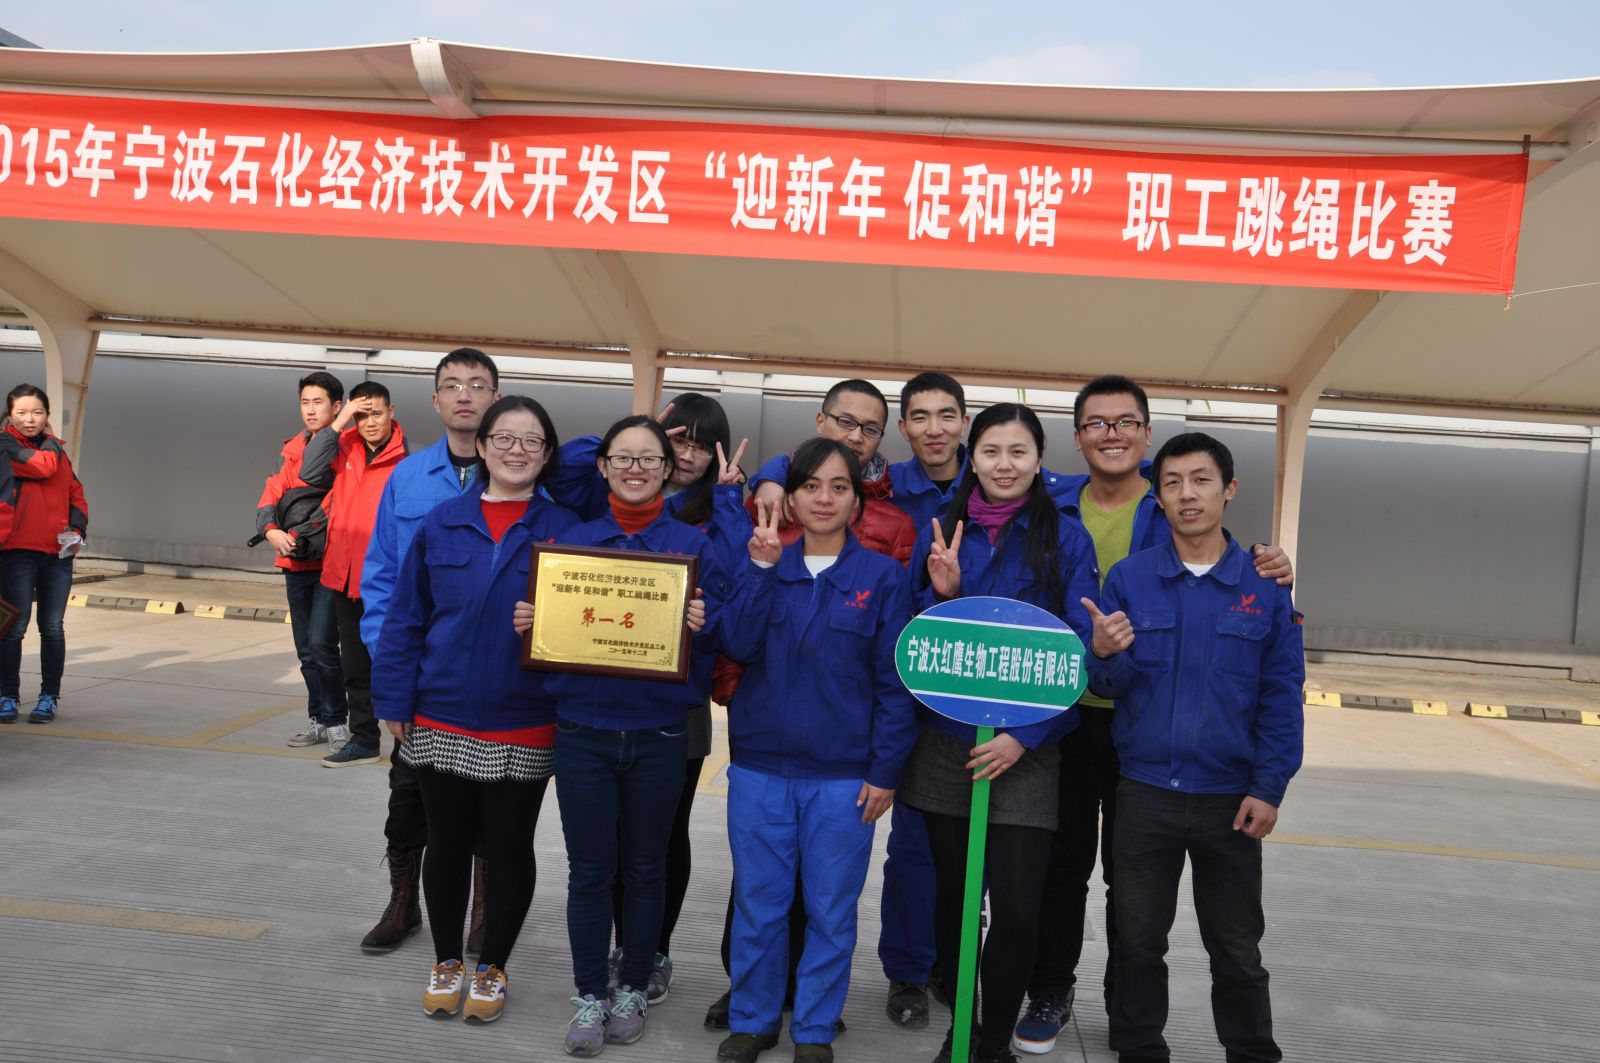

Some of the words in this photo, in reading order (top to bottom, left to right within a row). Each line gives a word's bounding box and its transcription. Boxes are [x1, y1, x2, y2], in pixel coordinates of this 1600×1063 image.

[1121, 170, 1458, 267] 职工跳绳比赛
[563, 571, 656, 587] 宁波石化经济技术开发区
[581, 607, 635, 629] 第一名
[907, 635, 1081, 690] 宁波大红鹰生物工程股份有限公司
